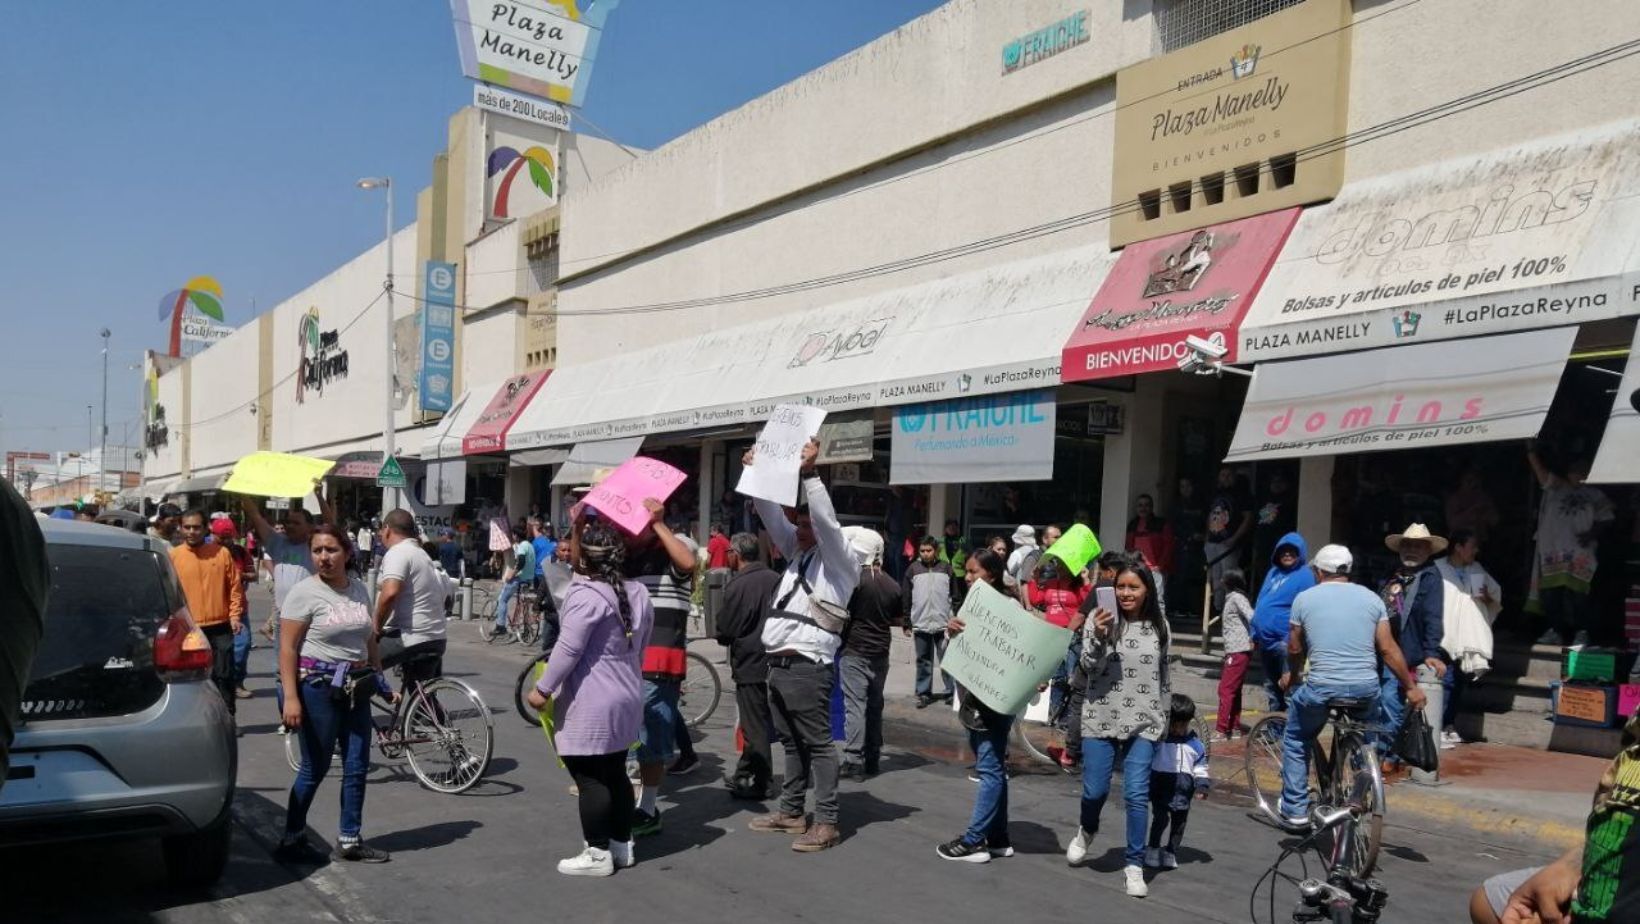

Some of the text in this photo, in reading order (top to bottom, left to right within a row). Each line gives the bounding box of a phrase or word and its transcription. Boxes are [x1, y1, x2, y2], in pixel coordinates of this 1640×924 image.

[491, 3, 564, 41] Plaza
[479, 30, 578, 80] Manelly
[1177, 67, 1223, 91] ENTRADA
[499, 95, 511, 111] de
[512, 98, 530, 116] 200
[531, 104, 568, 125] Locales
[1151, 105, 1210, 141] Plaza
[1211, 76, 1290, 122] Manelly
[1152, 129, 1281, 172] BIENVENIDOS
[1316, 180, 1597, 264] domins
[1281, 296, 1336, 314] Bolsas
[1336, 296, 1350, 310] y
[1353, 279, 1430, 304] artículos
[1437, 273, 1461, 290] de
[1465, 265, 1506, 293] piel
[1511, 254, 1568, 280] 100%
[1245, 330, 1291, 352] PLAZA
[1296, 321, 1372, 346] MANELLY
[1444, 291, 1608, 326] #LaPlazaReyna
[1086, 340, 1192, 371] BIENVENIDO
[880, 367, 1062, 398] PLAZA MANELLY #LaPlazaReyna
[1265, 394, 1485, 437] domins
[1384, 430, 1405, 442] de
[1407, 428, 1441, 443] piel
[1444, 423, 1489, 437] 100%
